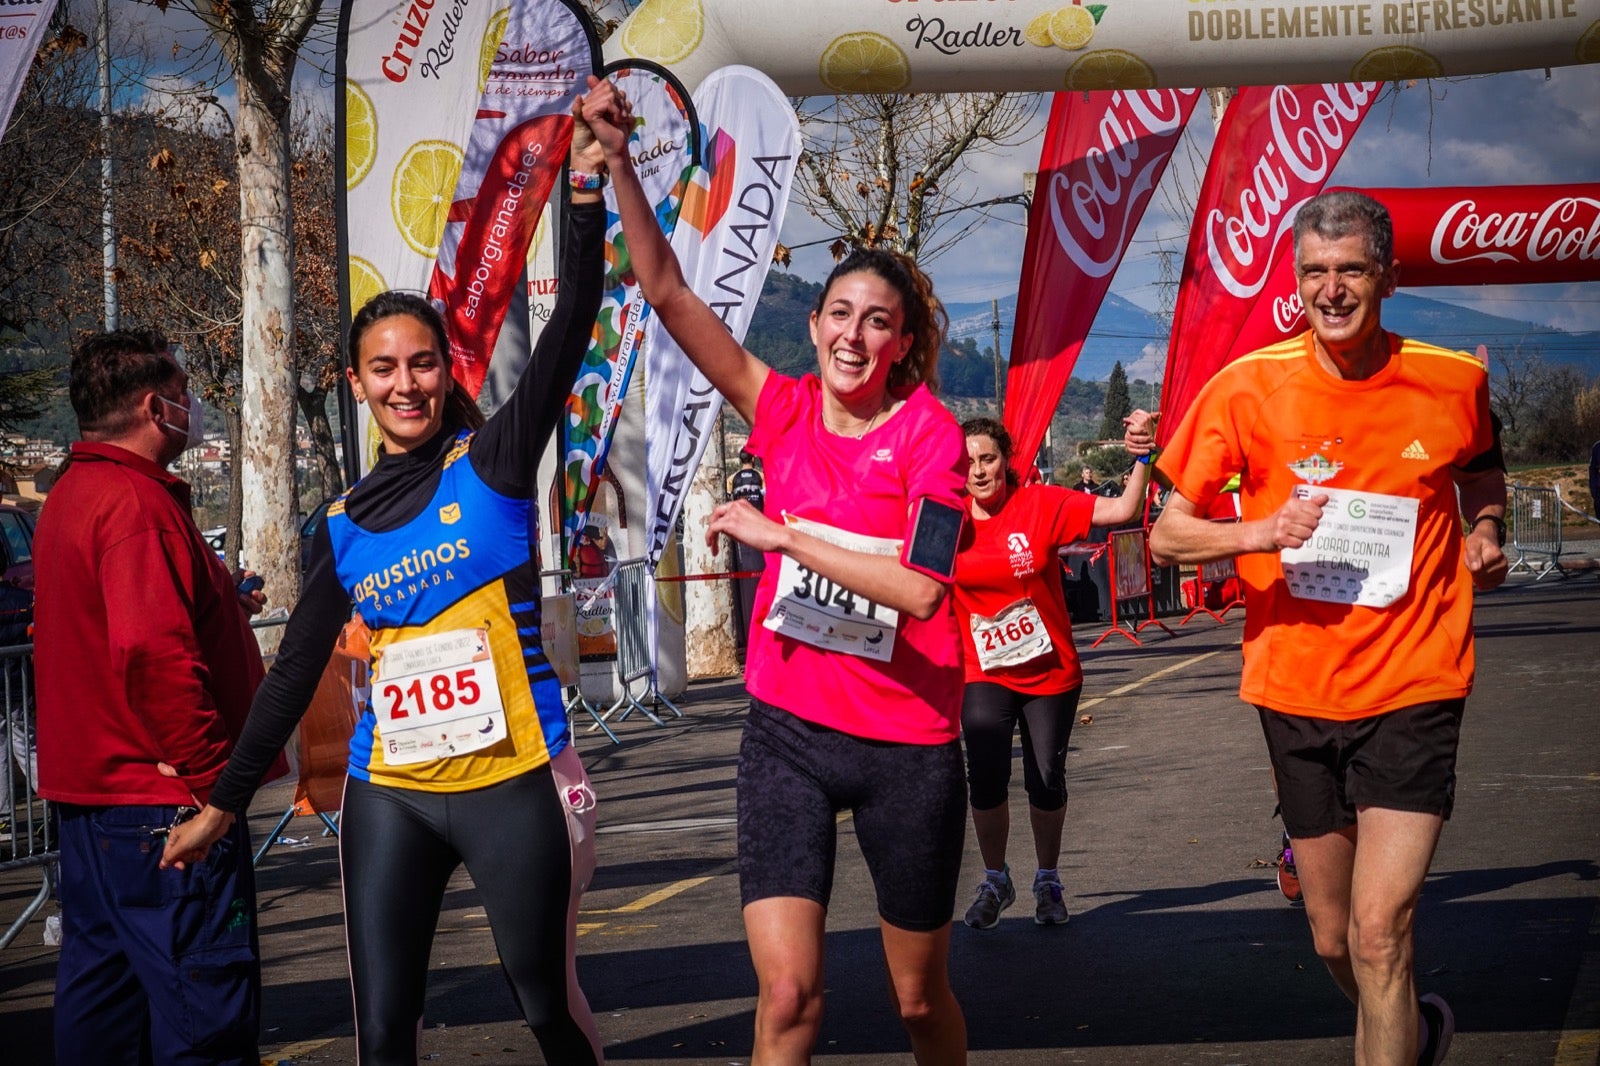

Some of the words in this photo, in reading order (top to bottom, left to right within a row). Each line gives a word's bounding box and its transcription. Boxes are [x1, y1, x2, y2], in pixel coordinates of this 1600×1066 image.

[906, 13, 1025, 55] Radler
[1188, 4, 1373, 41] DOBLEMENTE
[1382, 0, 1577, 34] REFRESCANTE
[494, 42, 563, 64] Sabor
[495, 84, 511, 95] de
[517, 86, 571, 99] siempre
[1050, 88, 1196, 278] Coca-C
[465, 142, 543, 320] saborgranada.es
[1431, 197, 1600, 265] Coca-Col
[603, 290, 644, 430] www.turgranada.e
[1401, 451, 1430, 460] adidas
[1316, 536, 1349, 554] CORRO
[1353, 540, 1390, 558] CONTRA
[1316, 553, 1326, 569] EL
[355, 538, 471, 603] agustinos
[374, 569, 455, 612] GRANADA
[981, 616, 1035, 651] 2166
[383, 668, 480, 720] 2185
